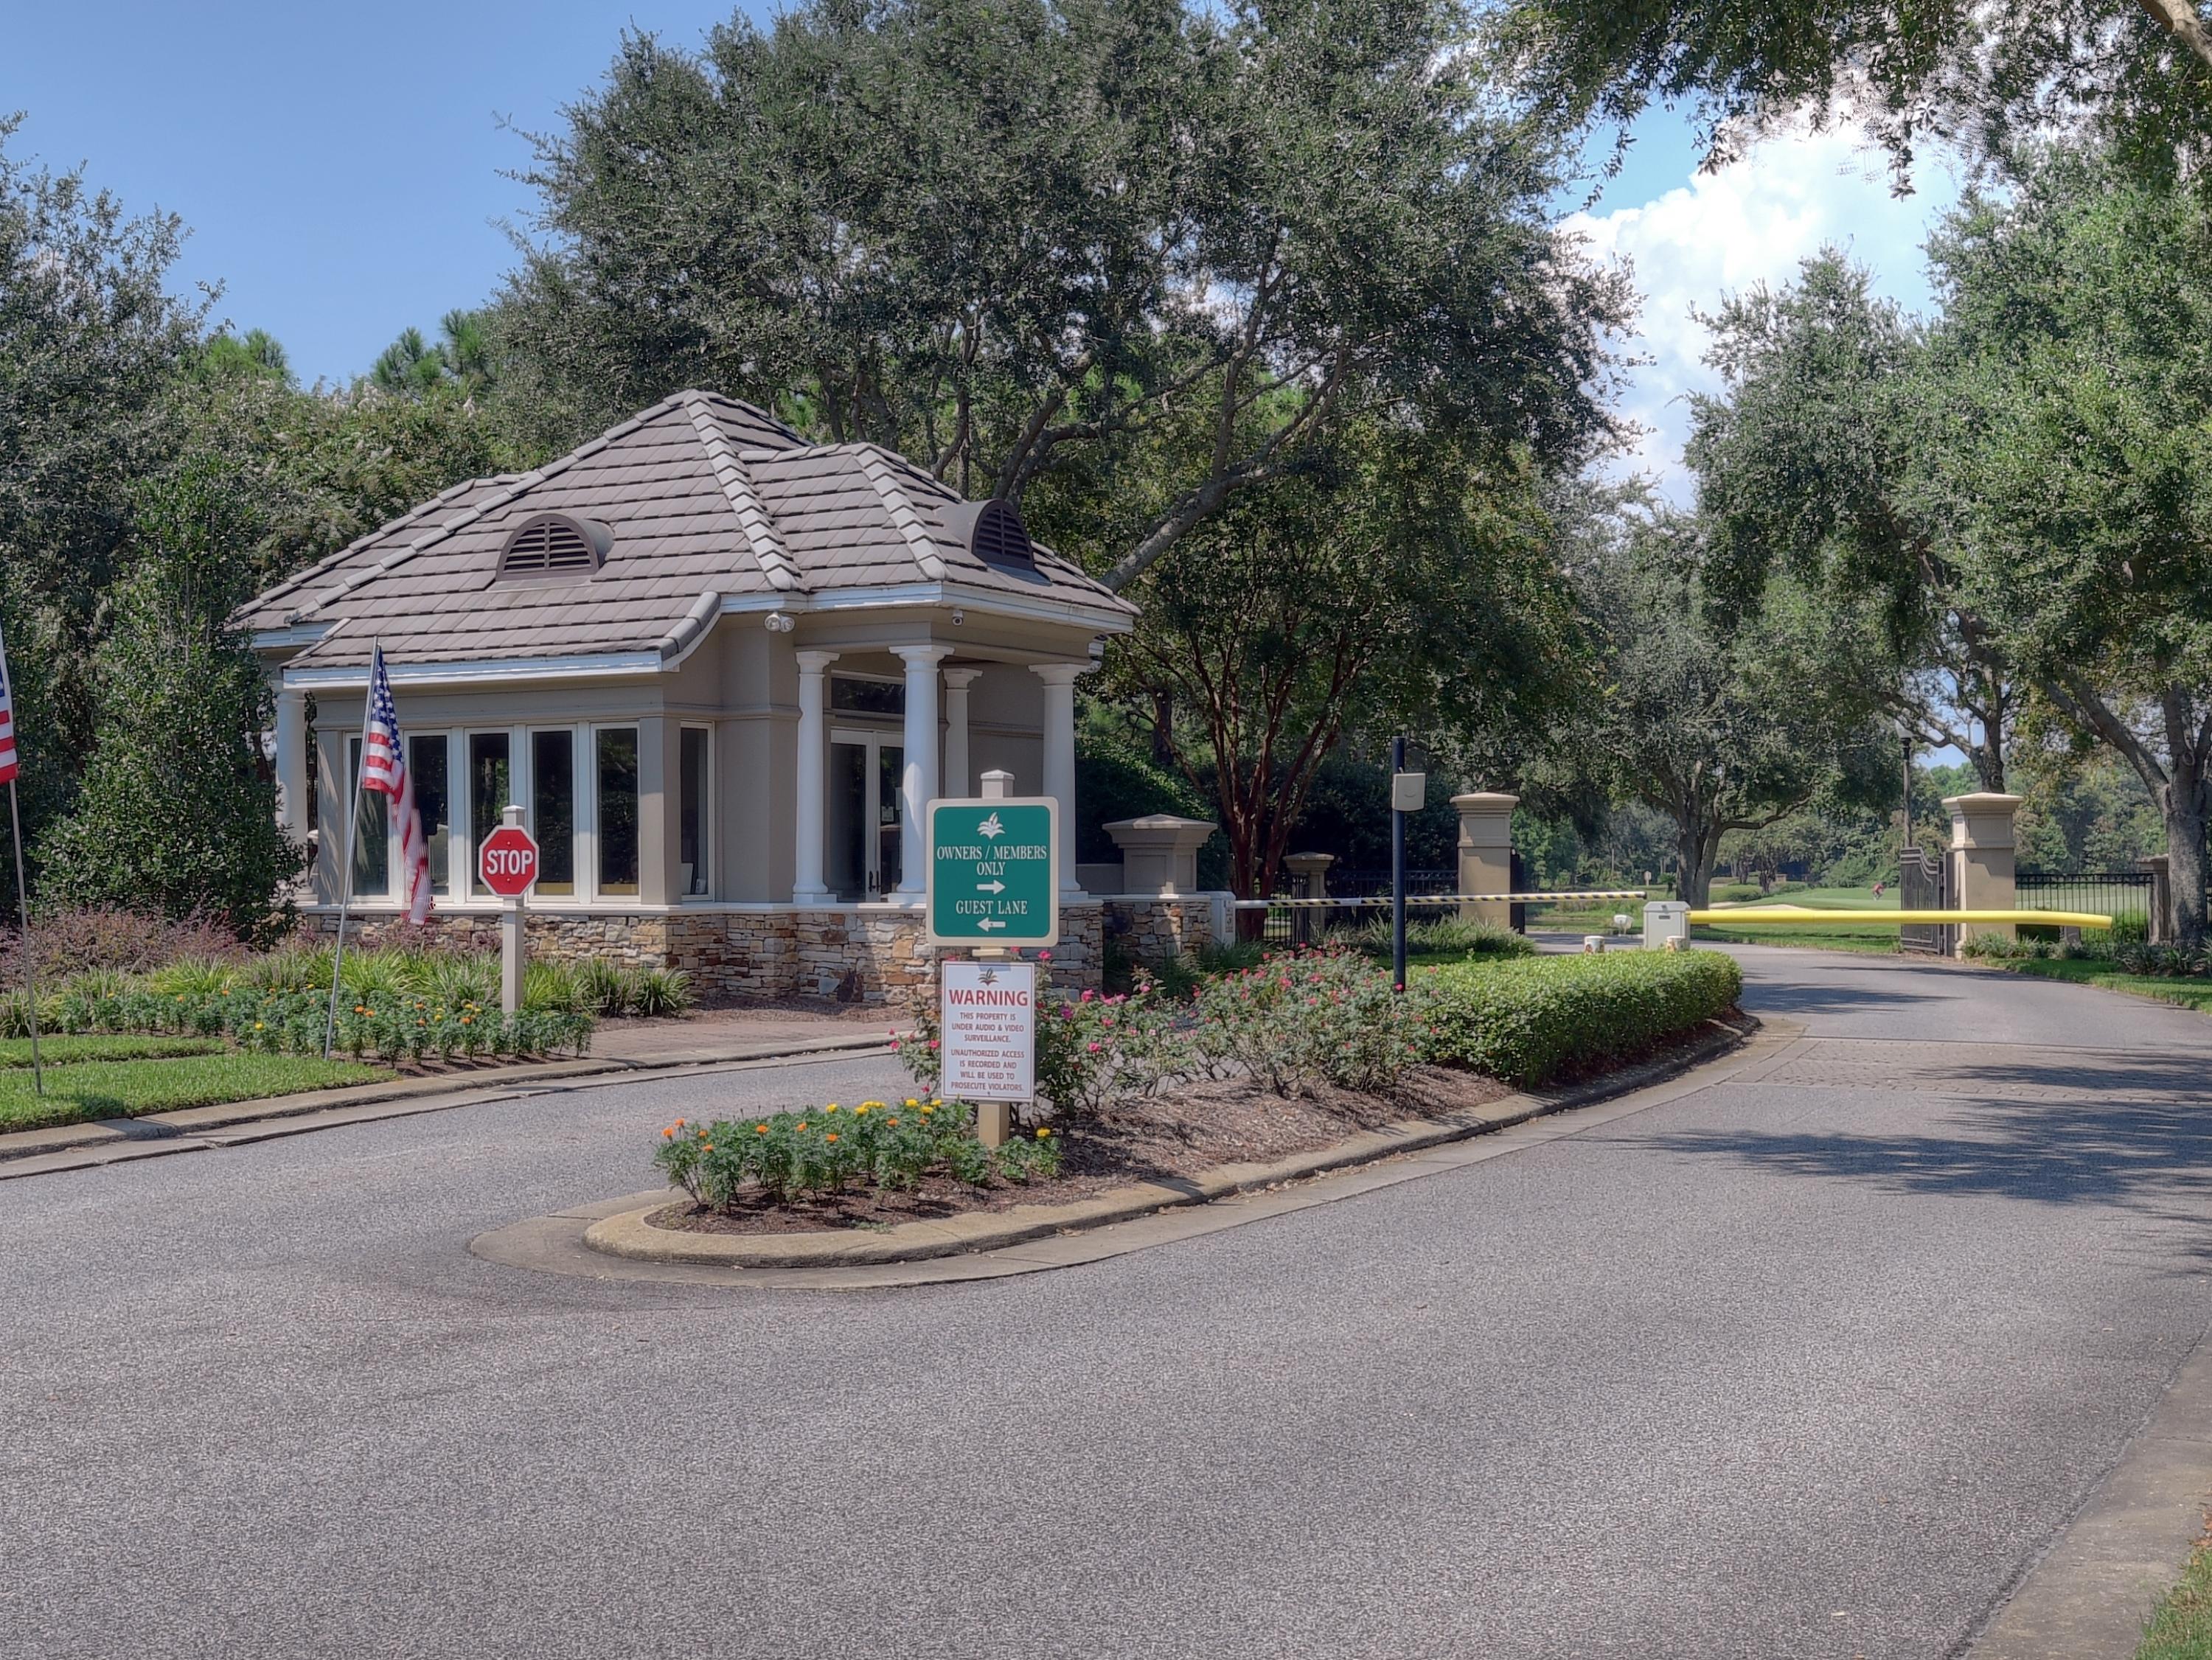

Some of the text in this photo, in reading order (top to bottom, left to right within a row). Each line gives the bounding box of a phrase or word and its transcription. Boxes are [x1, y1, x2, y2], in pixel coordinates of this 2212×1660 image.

[937, 845, 1047, 860] OWNERS / MEMBERS
[487, 849, 533, 875] STOP
[976, 862, 1006, 876] ONLY
[956, 900, 1028, 915] GUEST LANE
[949, 989, 1028, 1006] WARNING
[976, 1012, 1008, 1021] PROPERTY
[964, 1034, 1011, 1043] SURVEILLANCE.
[950, 1049, 999, 1057] UNAUTHORIZED
[967, 1061, 1001, 1069] RECORDED
[987, 1072, 1004, 1080] USED
[951, 1081, 1024, 1092] PROSECUTE VIOLATORS.
